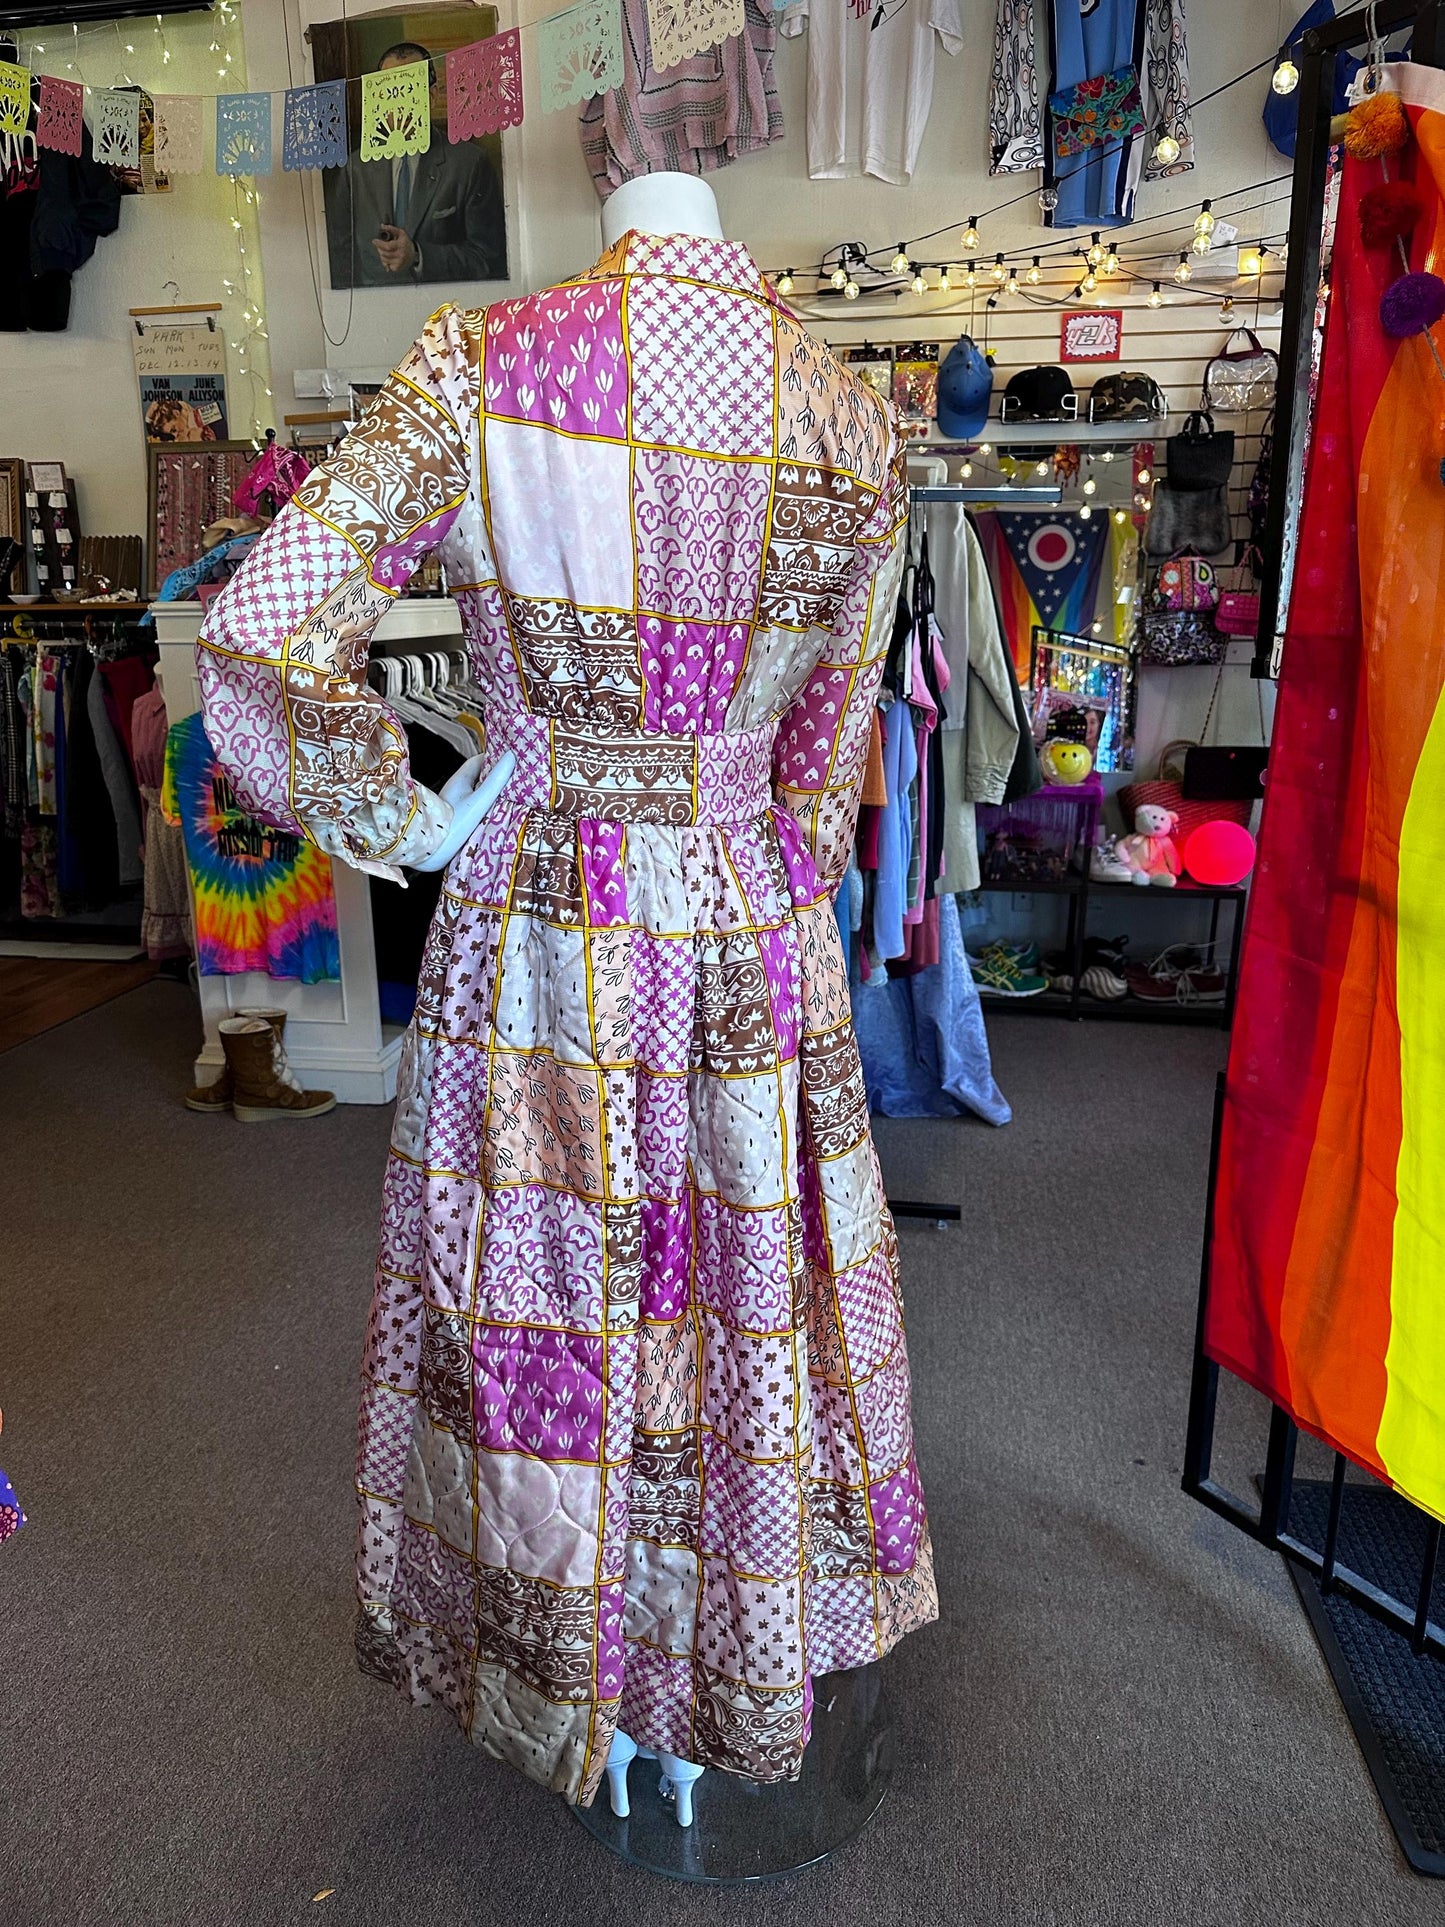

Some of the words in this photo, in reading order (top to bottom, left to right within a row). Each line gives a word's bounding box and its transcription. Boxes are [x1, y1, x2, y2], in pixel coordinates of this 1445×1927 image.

[136, 345, 155, 356] SUN
[165, 344, 185, 355] MON
[198, 343, 220, 352] TUES
[139, 361, 160, 371] DEC
[152, 378, 171, 390] VAN
[194, 377, 216, 389] JUNE
[142, 389, 183, 402] JOHNSON
[189, 389, 225, 402] ALLYSON
[267, 831, 299, 863] TRIP
